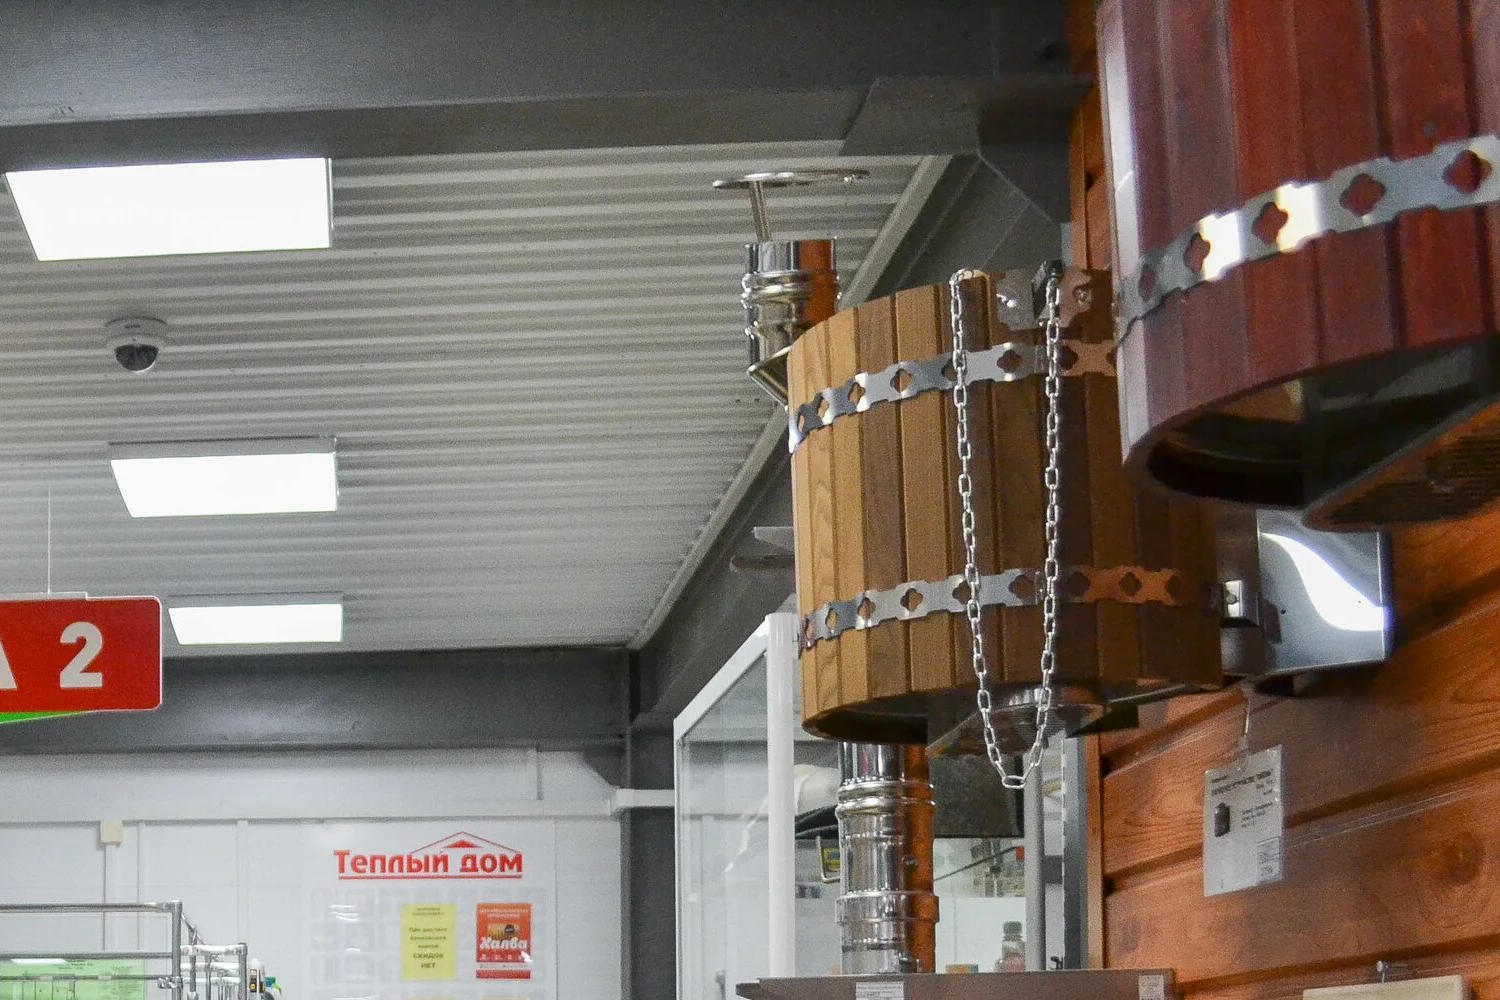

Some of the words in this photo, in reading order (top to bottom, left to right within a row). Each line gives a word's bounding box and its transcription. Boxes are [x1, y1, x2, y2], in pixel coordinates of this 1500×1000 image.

[59, 621, 103, 689] 2
[333, 848, 449, 874] Теплый
[459, 852, 523, 873] дом
